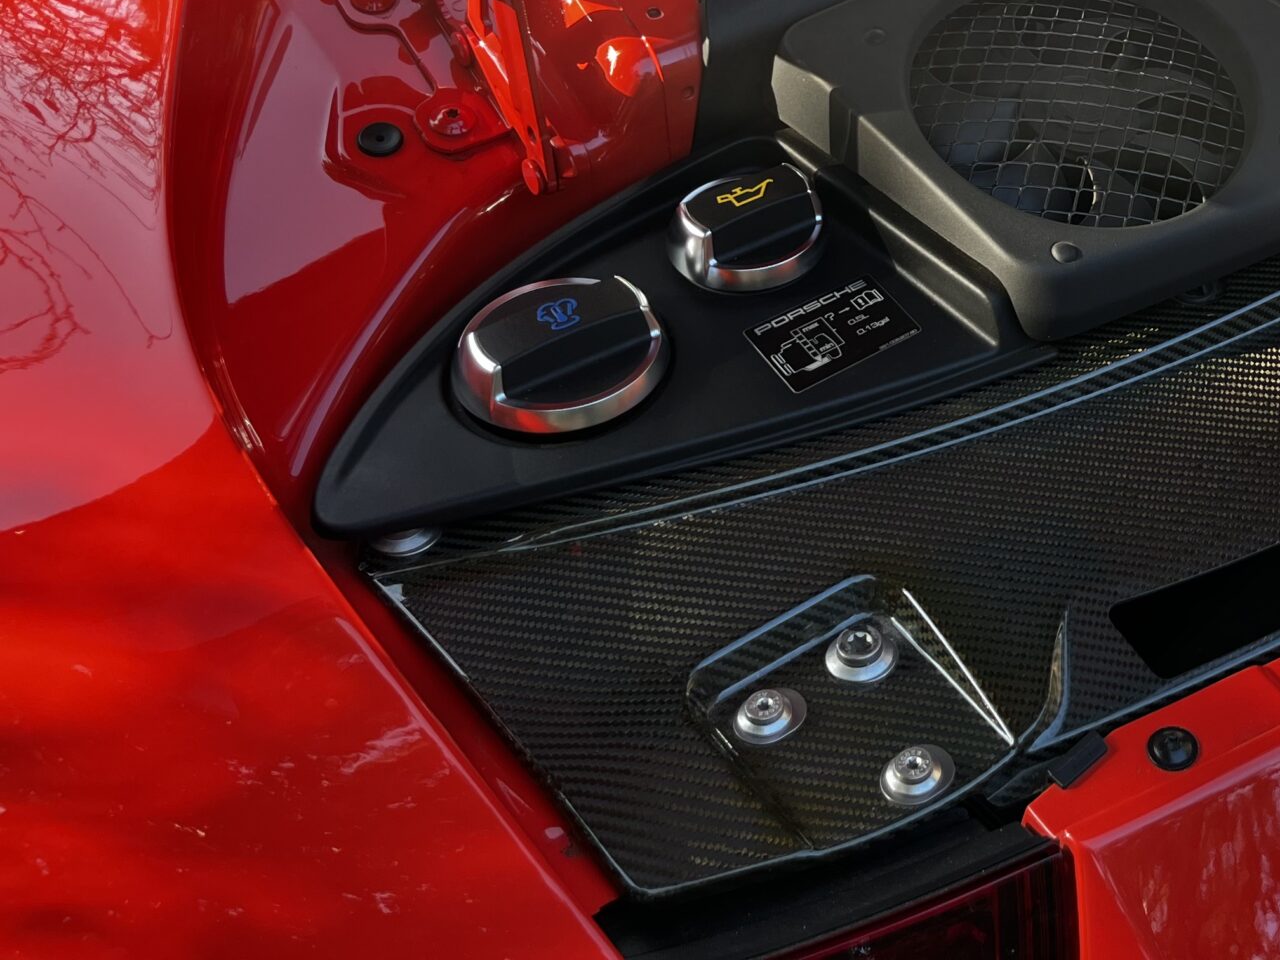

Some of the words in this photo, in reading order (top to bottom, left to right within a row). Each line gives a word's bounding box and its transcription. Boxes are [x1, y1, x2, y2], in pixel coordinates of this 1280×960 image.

[753, 279, 868, 337] PORSCHE
[801, 321, 820, 333] max
[819, 341, 835, 353] min
